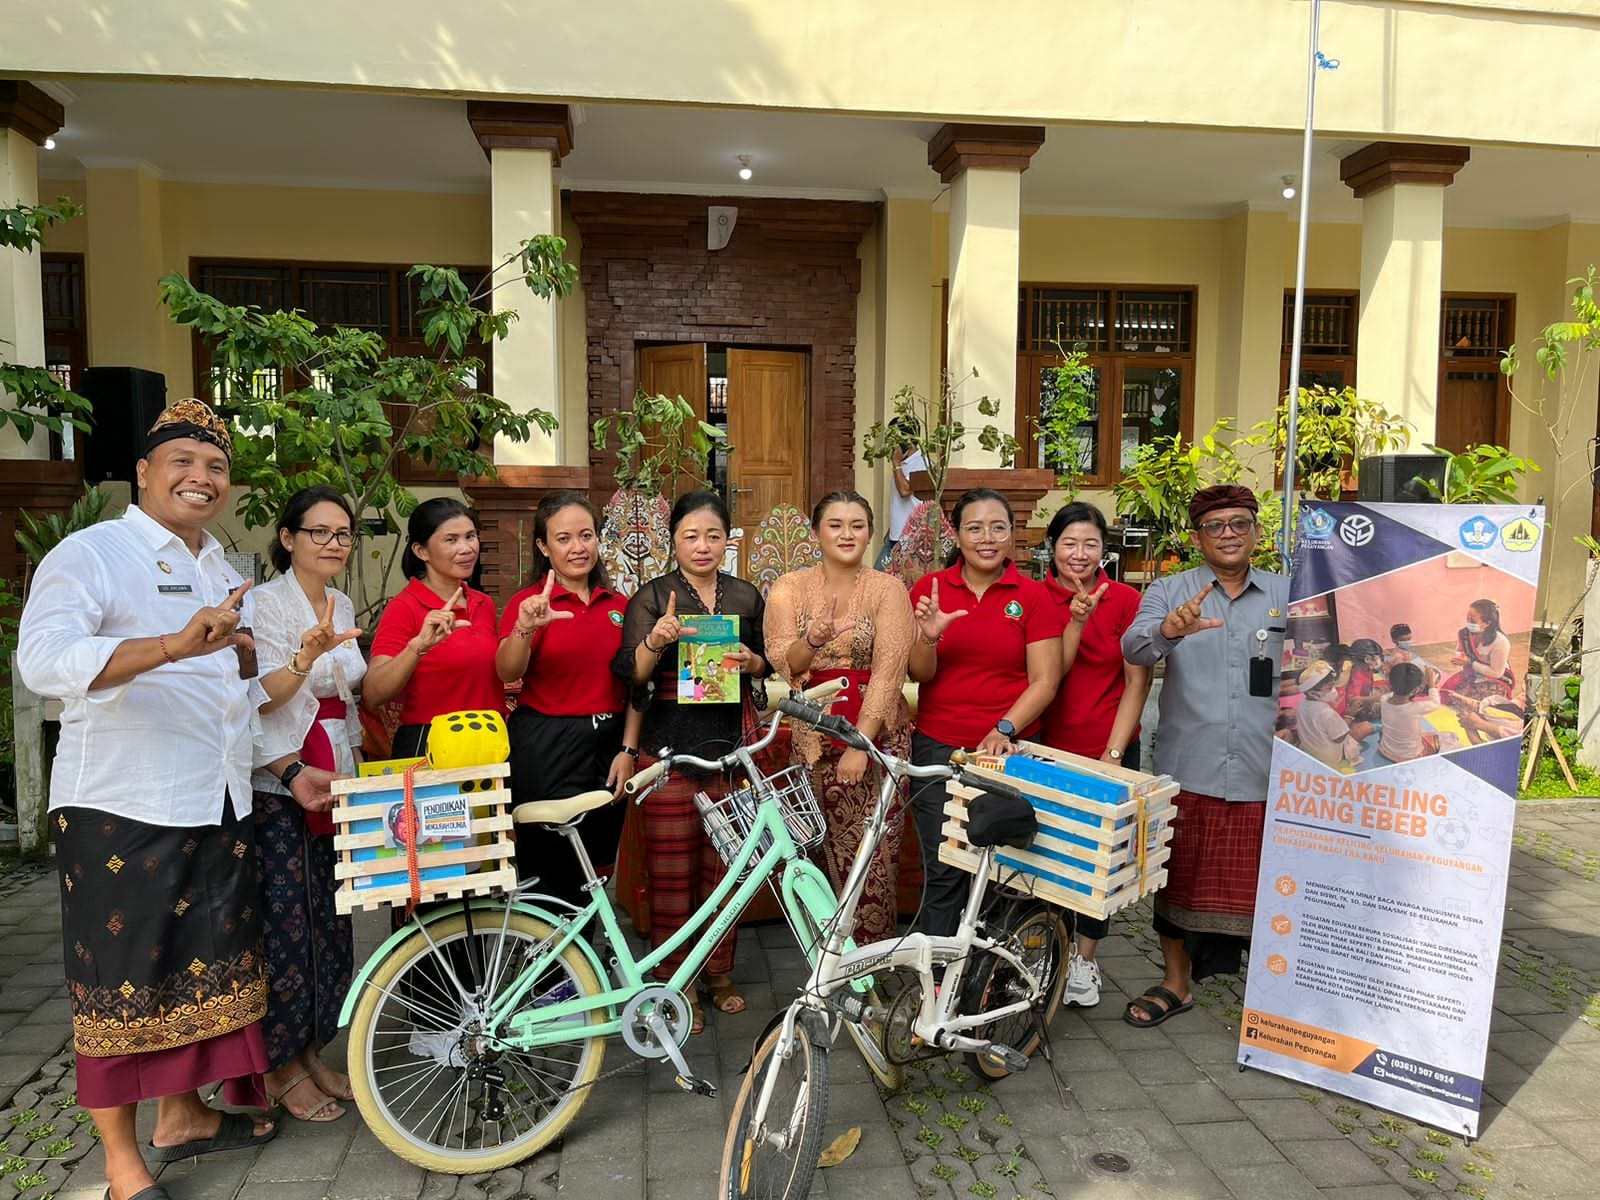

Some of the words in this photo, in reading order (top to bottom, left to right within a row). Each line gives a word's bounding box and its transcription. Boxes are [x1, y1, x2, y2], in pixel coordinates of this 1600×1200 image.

[424, 799, 466, 815] PENDIDIKAN
[1279, 769, 1448, 817] PUSTAKELING
[1274, 791, 1354, 824] AYANG
[1360, 806, 1428, 838] EBEB
[1303, 895, 1344, 909] PEGUYANGAN
[1260, 1017, 1336, 1045] kelurahanpeguyangan
[1259, 1031, 1294, 1048] Kelurahan
[1294, 1040, 1337, 1060] Peguyangan
[1391, 1058, 1418, 1075] (0361)
